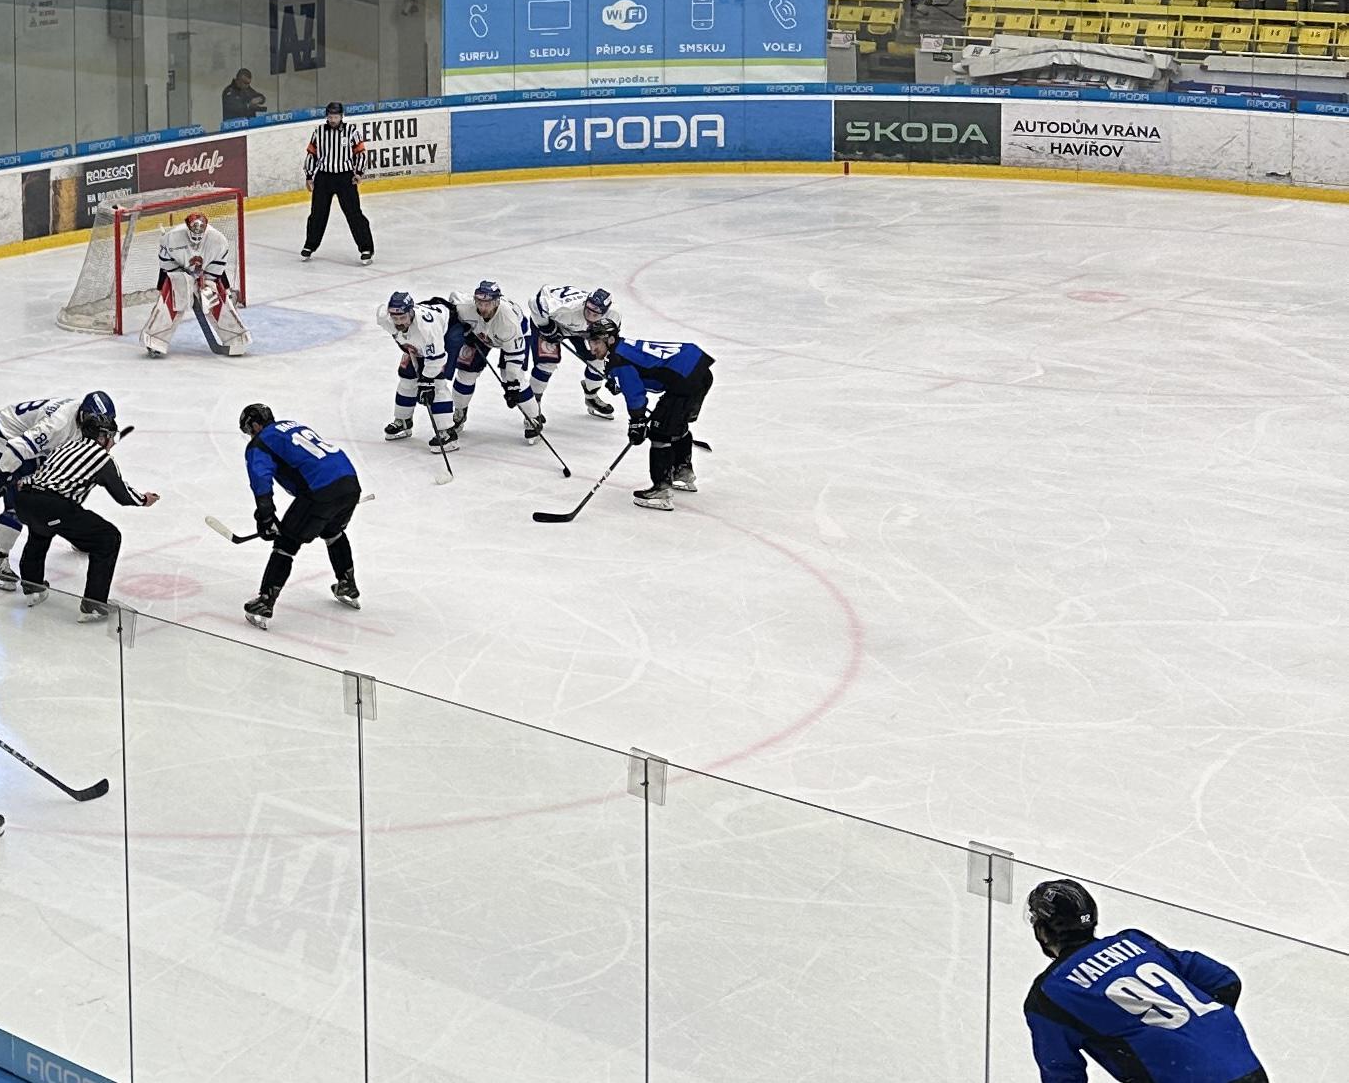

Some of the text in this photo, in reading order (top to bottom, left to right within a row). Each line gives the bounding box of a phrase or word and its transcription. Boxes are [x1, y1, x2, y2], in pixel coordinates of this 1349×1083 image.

[459, 50, 499, 61] SURFUJ
[529, 47, 571, 58] SLEDUJ
[596, 42, 654, 56] PŘIPOJ SE
[763, 42, 803, 53] VOLEJ
[590, 73, 660, 86] www.poda.cz
[362, 117, 418, 143] EKTRO
[584, 114, 725, 151] PODA
[1013, 119, 1162, 140] AUTODŮM VRÁNA
[367, 143, 438, 170] RGENCY
[1050, 140, 1124, 158] HAVÍŘOV
[86, 163, 135, 185] RADEGAST
[1066, 939, 1147, 989] VALENTA
[1105, 962, 1224, 1030] 92
